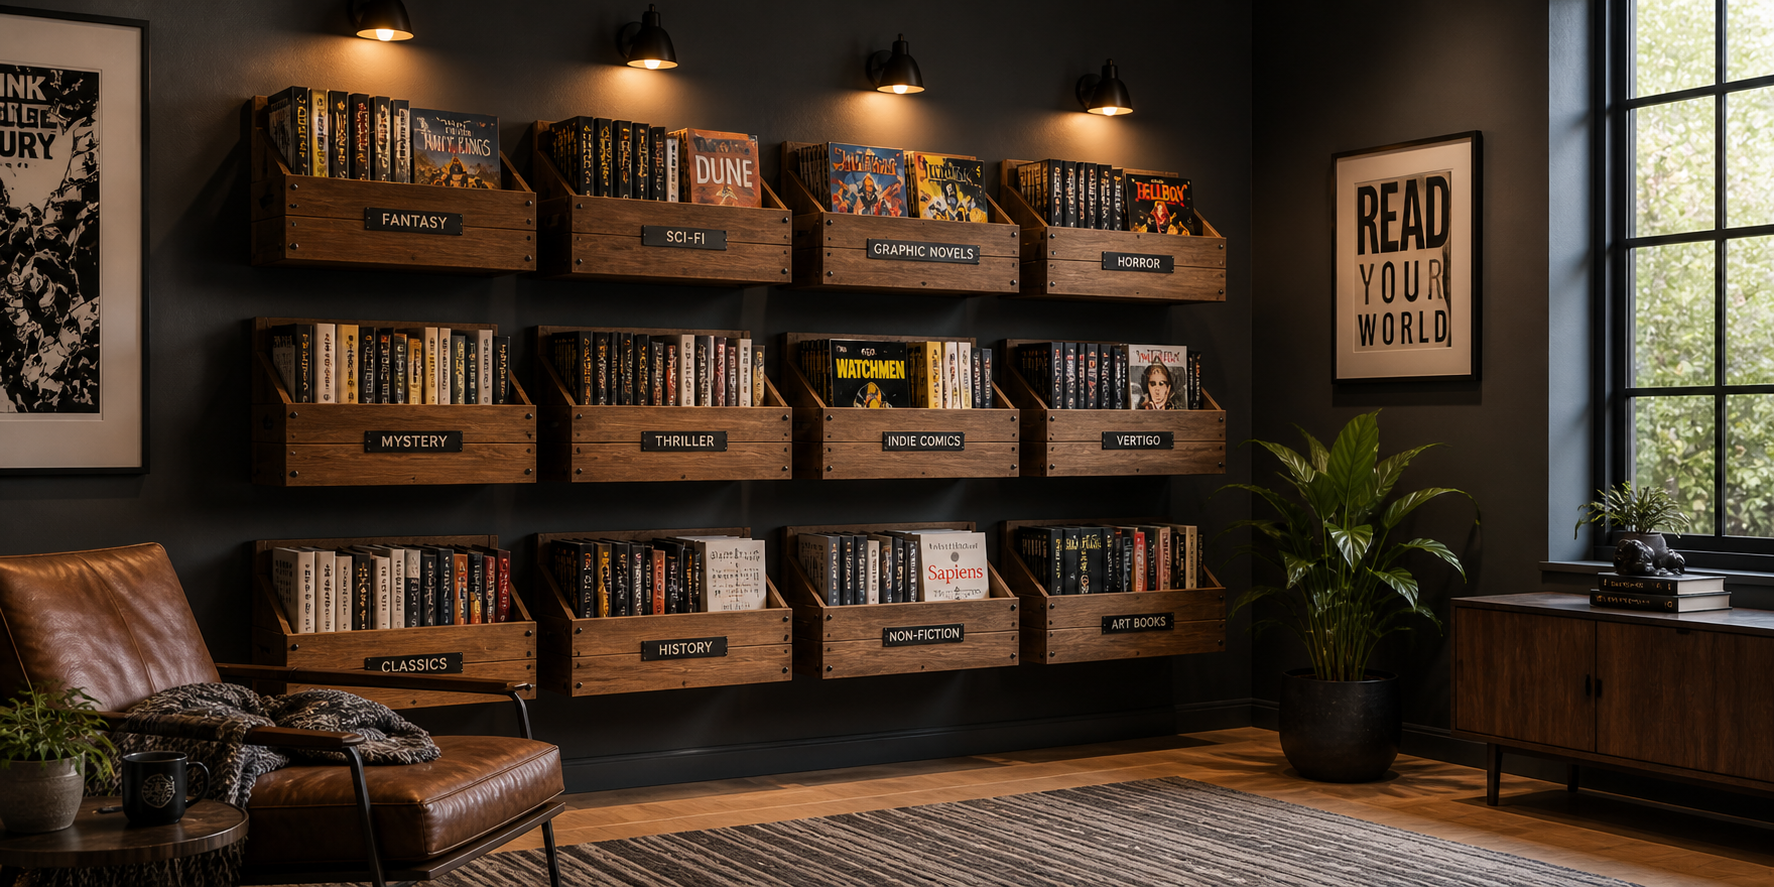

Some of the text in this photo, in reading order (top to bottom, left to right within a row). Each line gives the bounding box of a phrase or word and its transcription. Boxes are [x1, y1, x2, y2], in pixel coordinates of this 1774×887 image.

[695, 154, 753, 188] DUNE
[1135, 181, 1188, 206] HELLBOY
[382, 213, 448, 230] FANTASY
[1357, 175, 1450, 255] READ
[666, 230, 705, 245] SCI-FI
[873, 243, 974, 260] GRAPHIC NOVELS
[1117, 256, 1161, 270] HORROR
[1358, 258, 1443, 305] YOUR
[1357, 309, 1448, 347] WORLD
[835, 358, 906, 379] WATCHMEN
[381, 435, 448, 448] MYSTERY
[655, 435, 715, 447] THRILLER
[887, 435, 961, 448] INDIE COMICS
[1116, 435, 1161, 447] VERTIGO
[928, 564, 984, 585] Sapiens
[1111, 616, 1166, 630] ART BOOKS
[889, 627, 960, 643] NON-FICTION
[659, 640, 713, 657] HISTORY
[381, 657, 448, 673] CLASSICS
